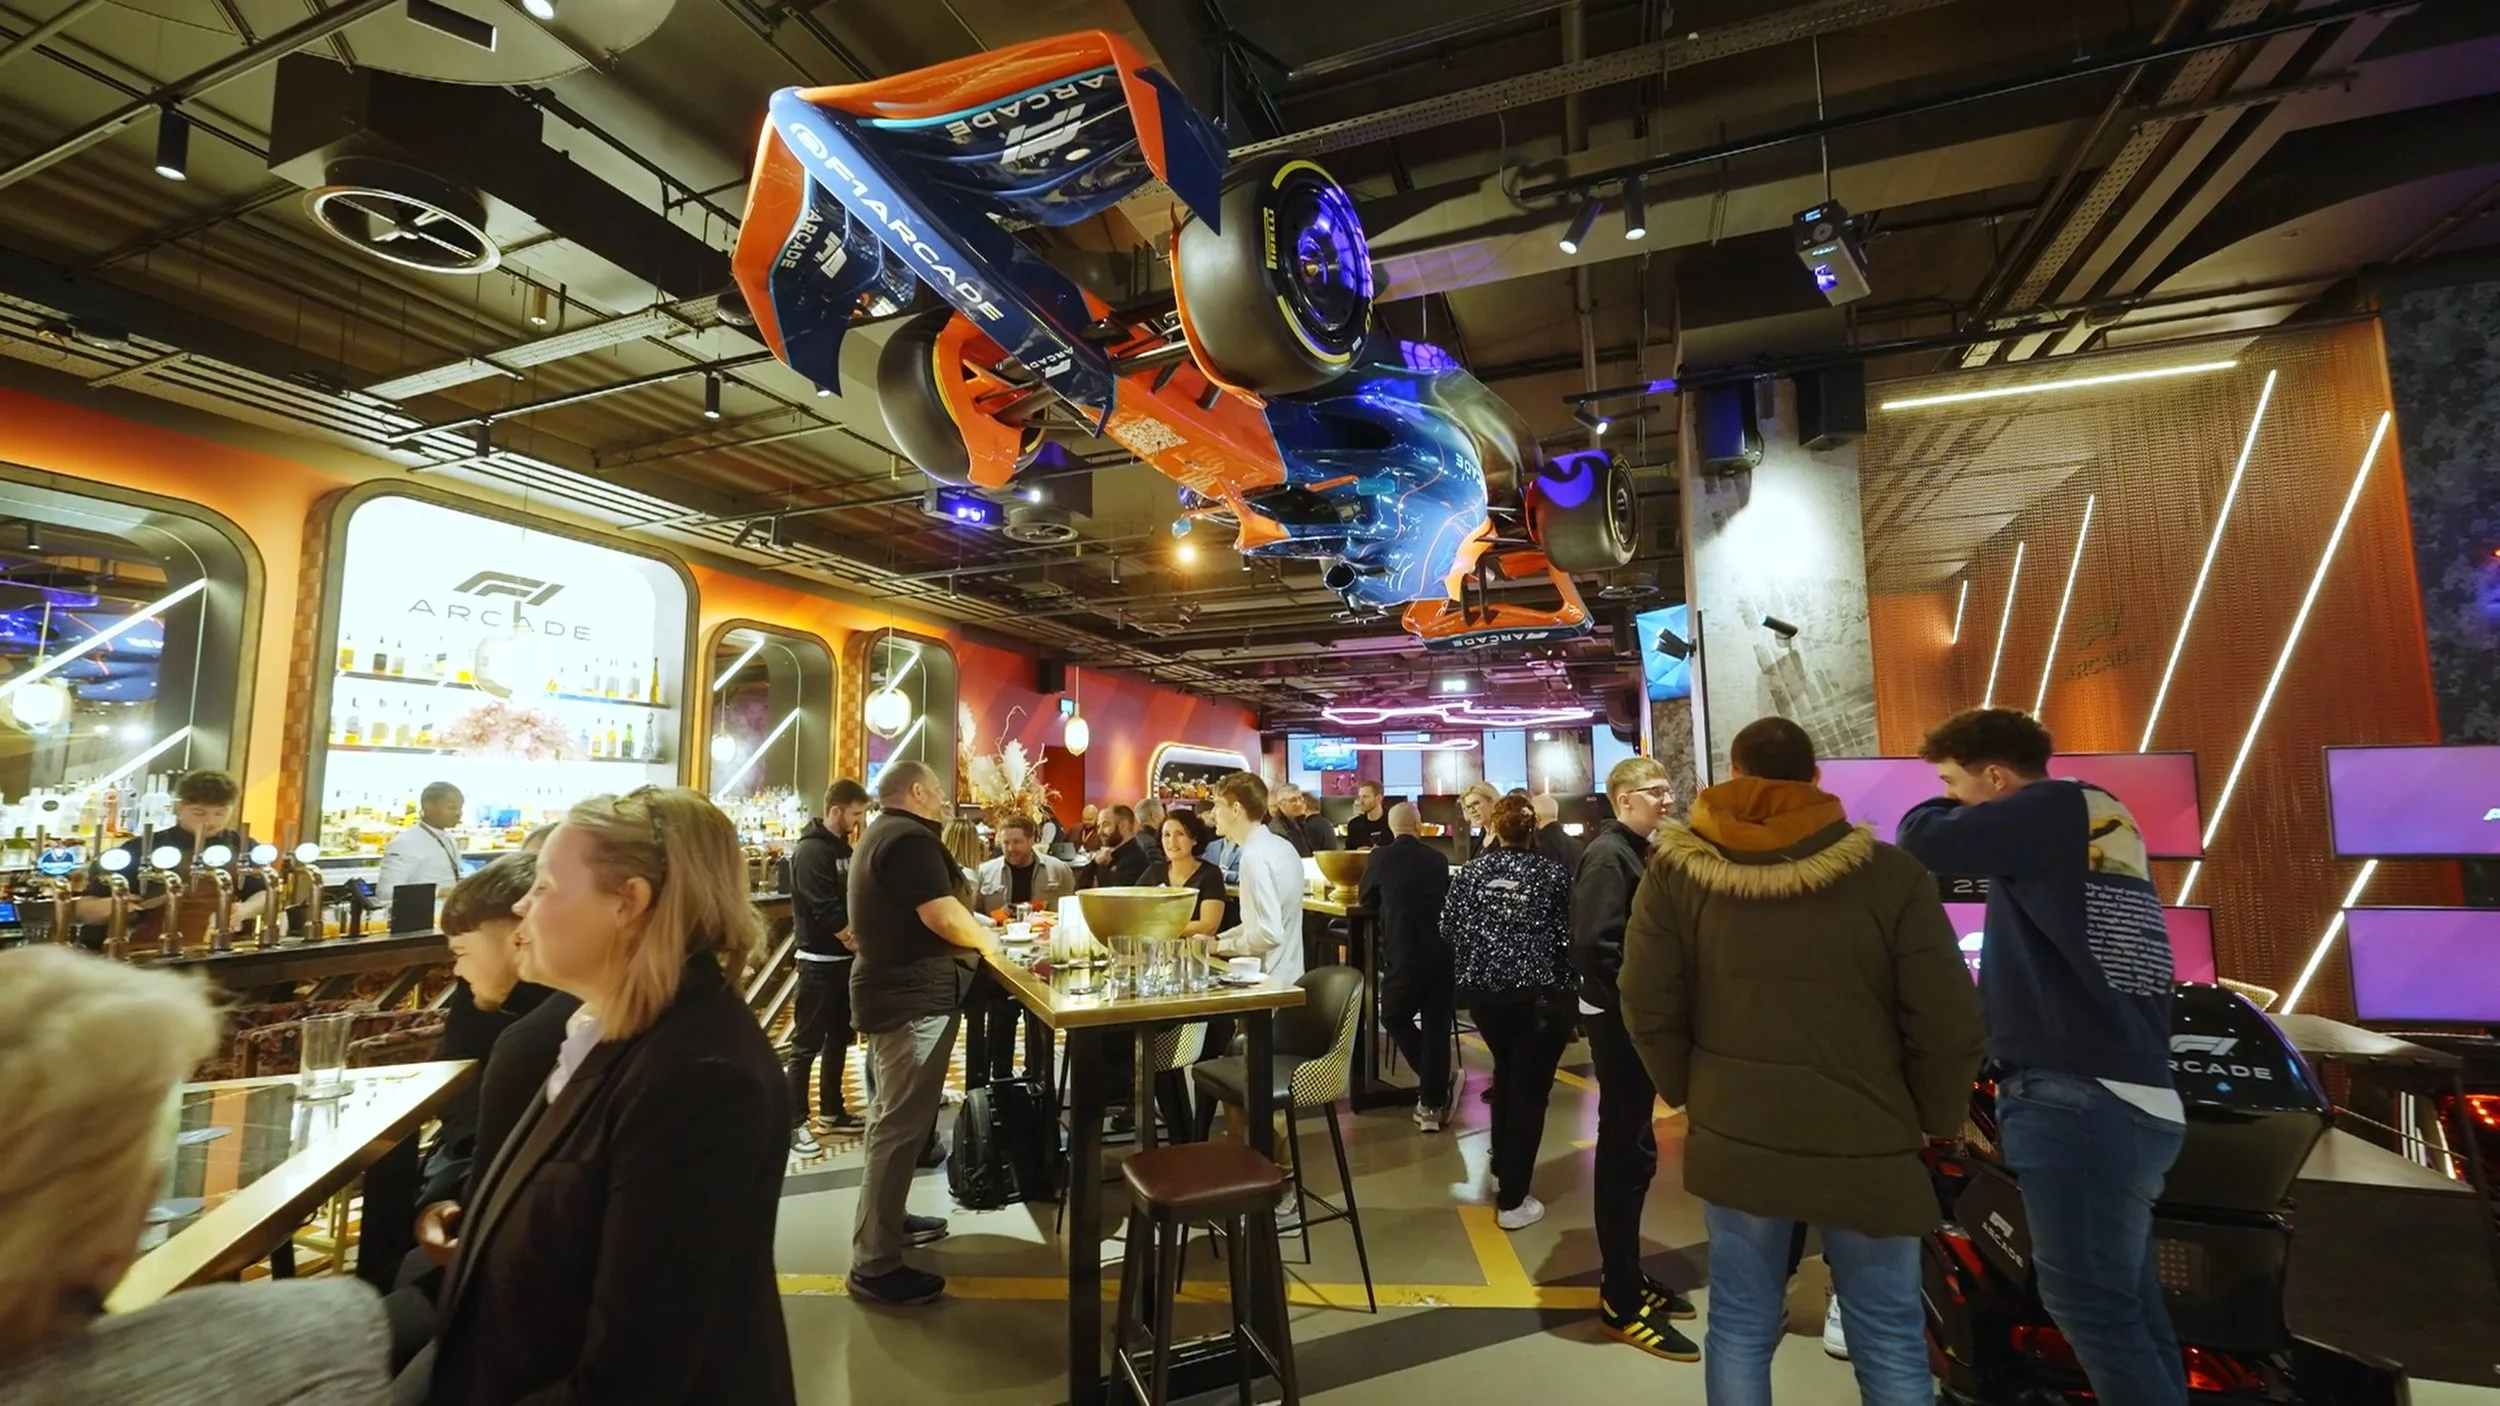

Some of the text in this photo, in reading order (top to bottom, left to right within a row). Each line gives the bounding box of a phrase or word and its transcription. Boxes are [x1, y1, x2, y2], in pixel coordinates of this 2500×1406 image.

[944, 74, 1105, 138] ARCADE
[780, 208, 824, 269] ARCADE
[1452, 632, 1525, 647] ARCADE
[2166, 1059, 2273, 1080] RCADE
[1982, 1221, 2024, 1268] ARCADE
